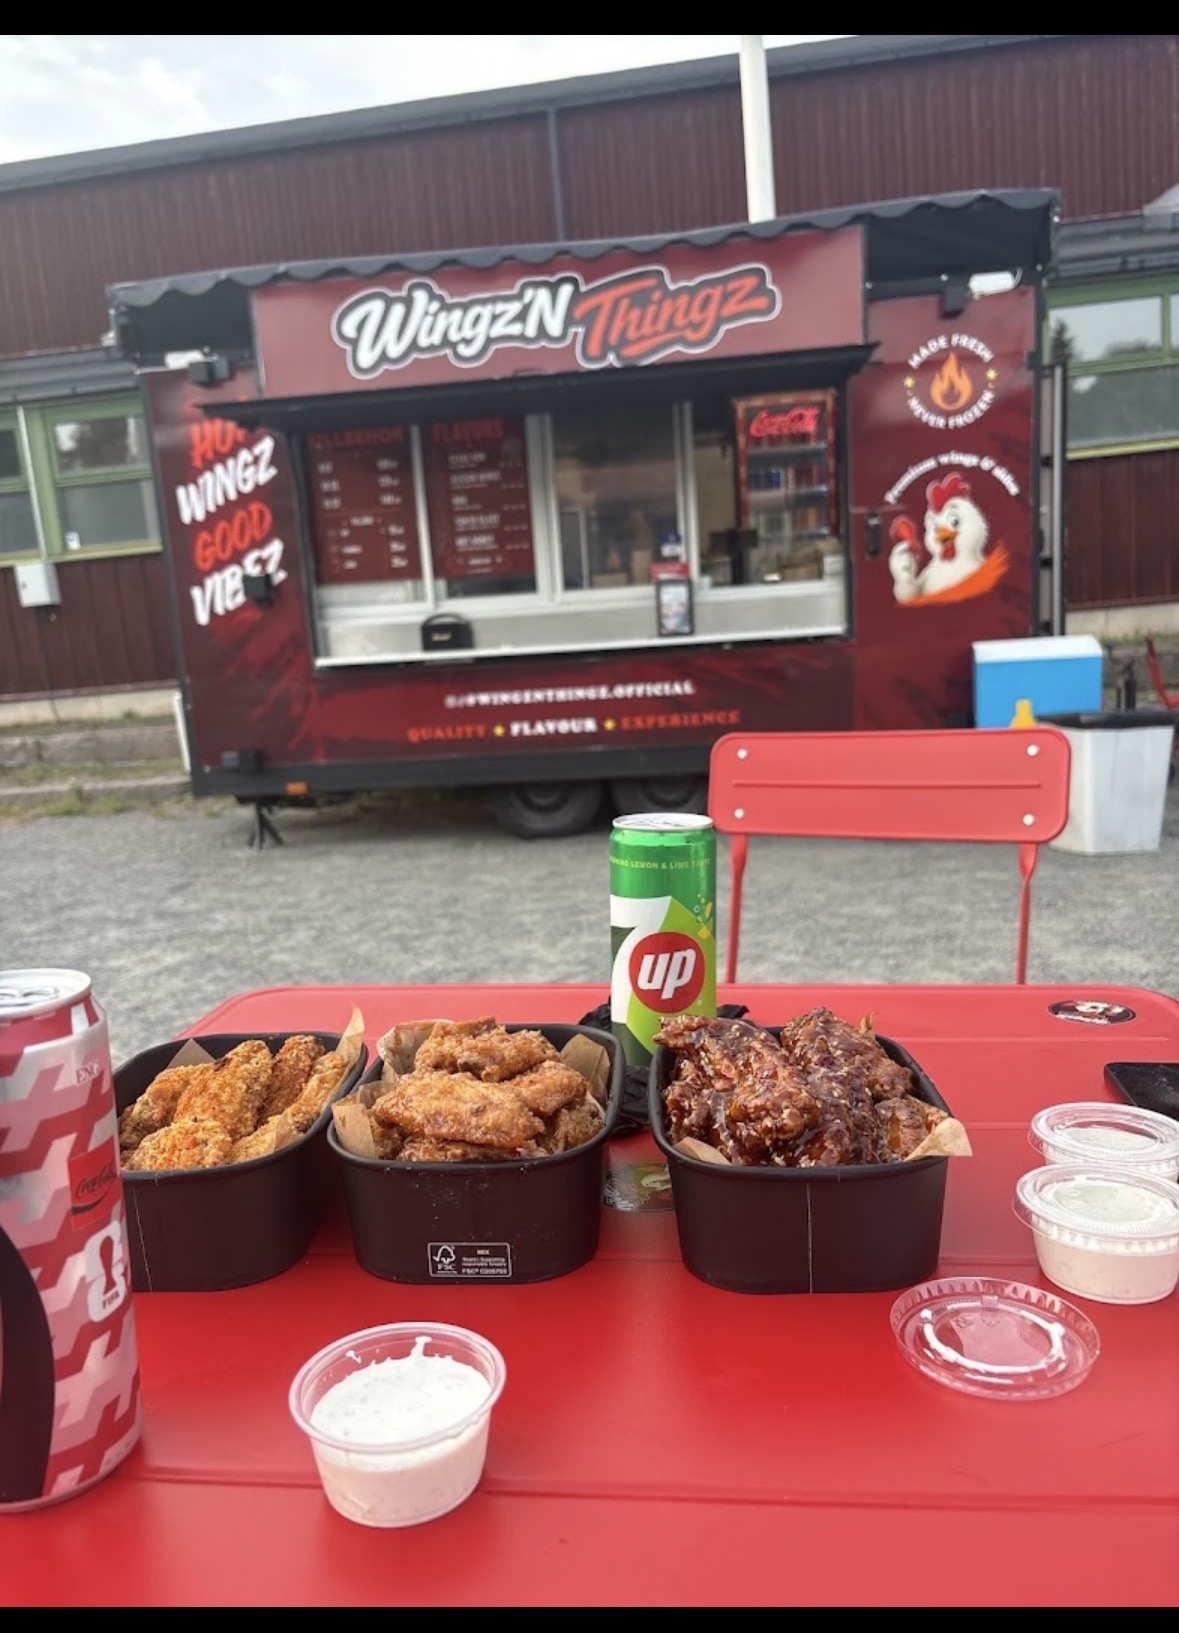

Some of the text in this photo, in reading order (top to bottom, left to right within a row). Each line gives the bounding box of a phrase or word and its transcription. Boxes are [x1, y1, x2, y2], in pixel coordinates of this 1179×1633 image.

[340, 275, 769, 369] Wingz'N Thingz
[907, 333, 995, 369] MADE FRESH
[907, 389, 996, 430] NEVER FROZEN
[191, 418, 247, 468] HO
[176, 435, 279, 525] WINGZ
[193, 501, 274, 571] GOOD
[406, 710, 741, 743] QUALITY FLAVOUR EXPERIENCE
[630, 860, 659, 870] LEMON
[437, 1263, 457, 1271] FSC
[102, 1289, 120, 1310] FIFA
